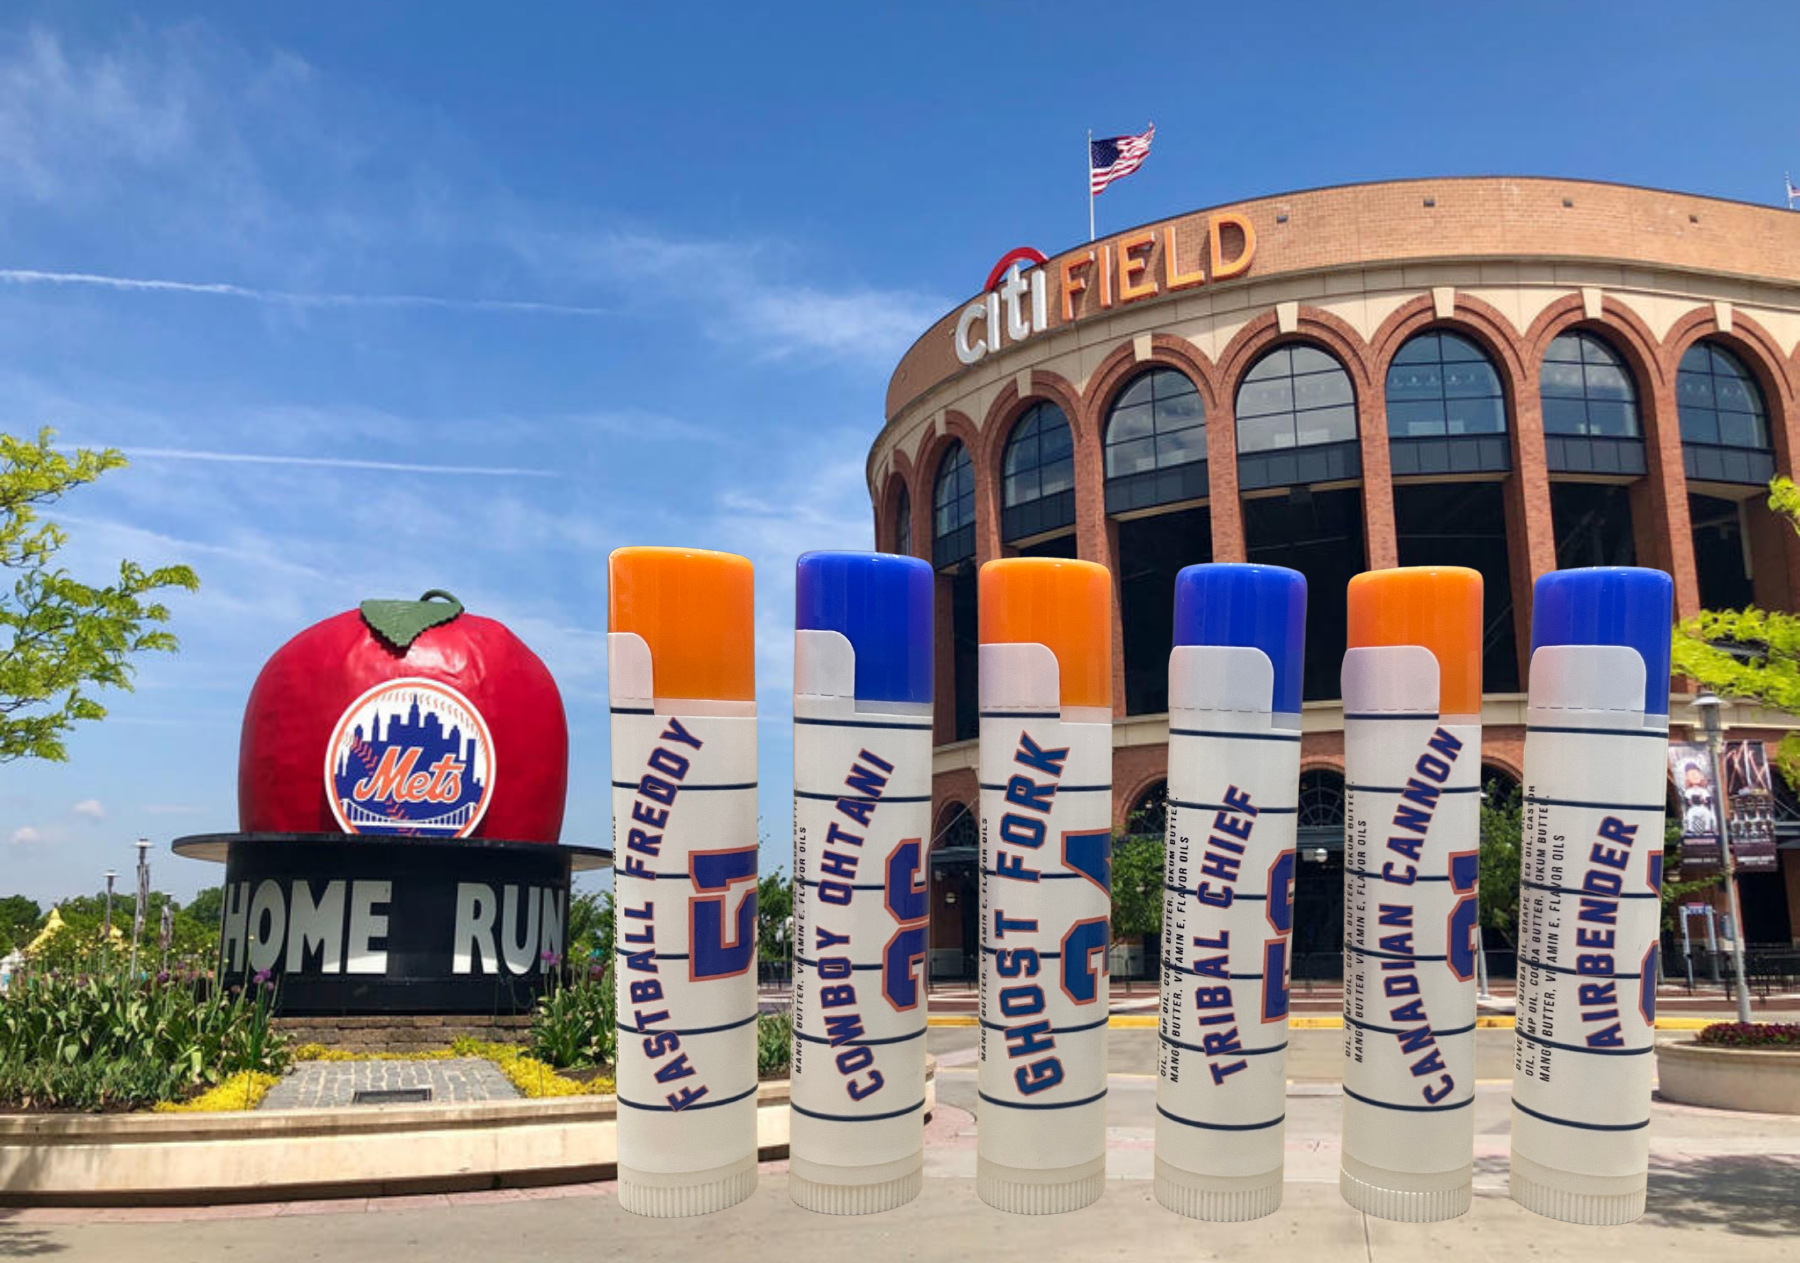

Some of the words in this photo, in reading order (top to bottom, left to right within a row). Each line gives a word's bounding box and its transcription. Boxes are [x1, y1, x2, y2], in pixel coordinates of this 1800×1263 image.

[955, 247, 1048, 364] citi
[1061, 212, 1257, 321] FIELD
[354, 745, 464, 803] Mets
[625, 717, 703, 880] FREDDY
[818, 748, 895, 906] OHTANI
[996, 730, 1069, 883] FORK
[1358, 820, 1367, 846] OILS
[1380, 727, 1464, 887] CANNON
[1177, 868, 1187, 913] FLAVOR
[1178, 836, 1189, 862] OILS
[1196, 784, 1261, 909] CHIEF
[1357, 851, 1366, 896] FLAVOR
[1549, 866, 1563, 911] FLAVOR
[1552, 835, 1565, 861] OILS
[222, 879, 392, 975] HOME
[452, 881, 566, 975] RUN
[1356, 916, 1365, 964] VIAMIN
[1545, 933, 1558, 982] VIAMIN
[1576, 815, 1638, 1049] AIRBENDER
[624, 901, 709, 1112] FASTBALL
[816, 927, 884, 1102] COWBOY
[994, 910, 1064, 1097] GHOST
[1193, 930, 1247, 1085] TRIBAL
[1377, 903, 1455, 1104] CANADIAN
[1527, 1017, 1536, 1050] HMP
